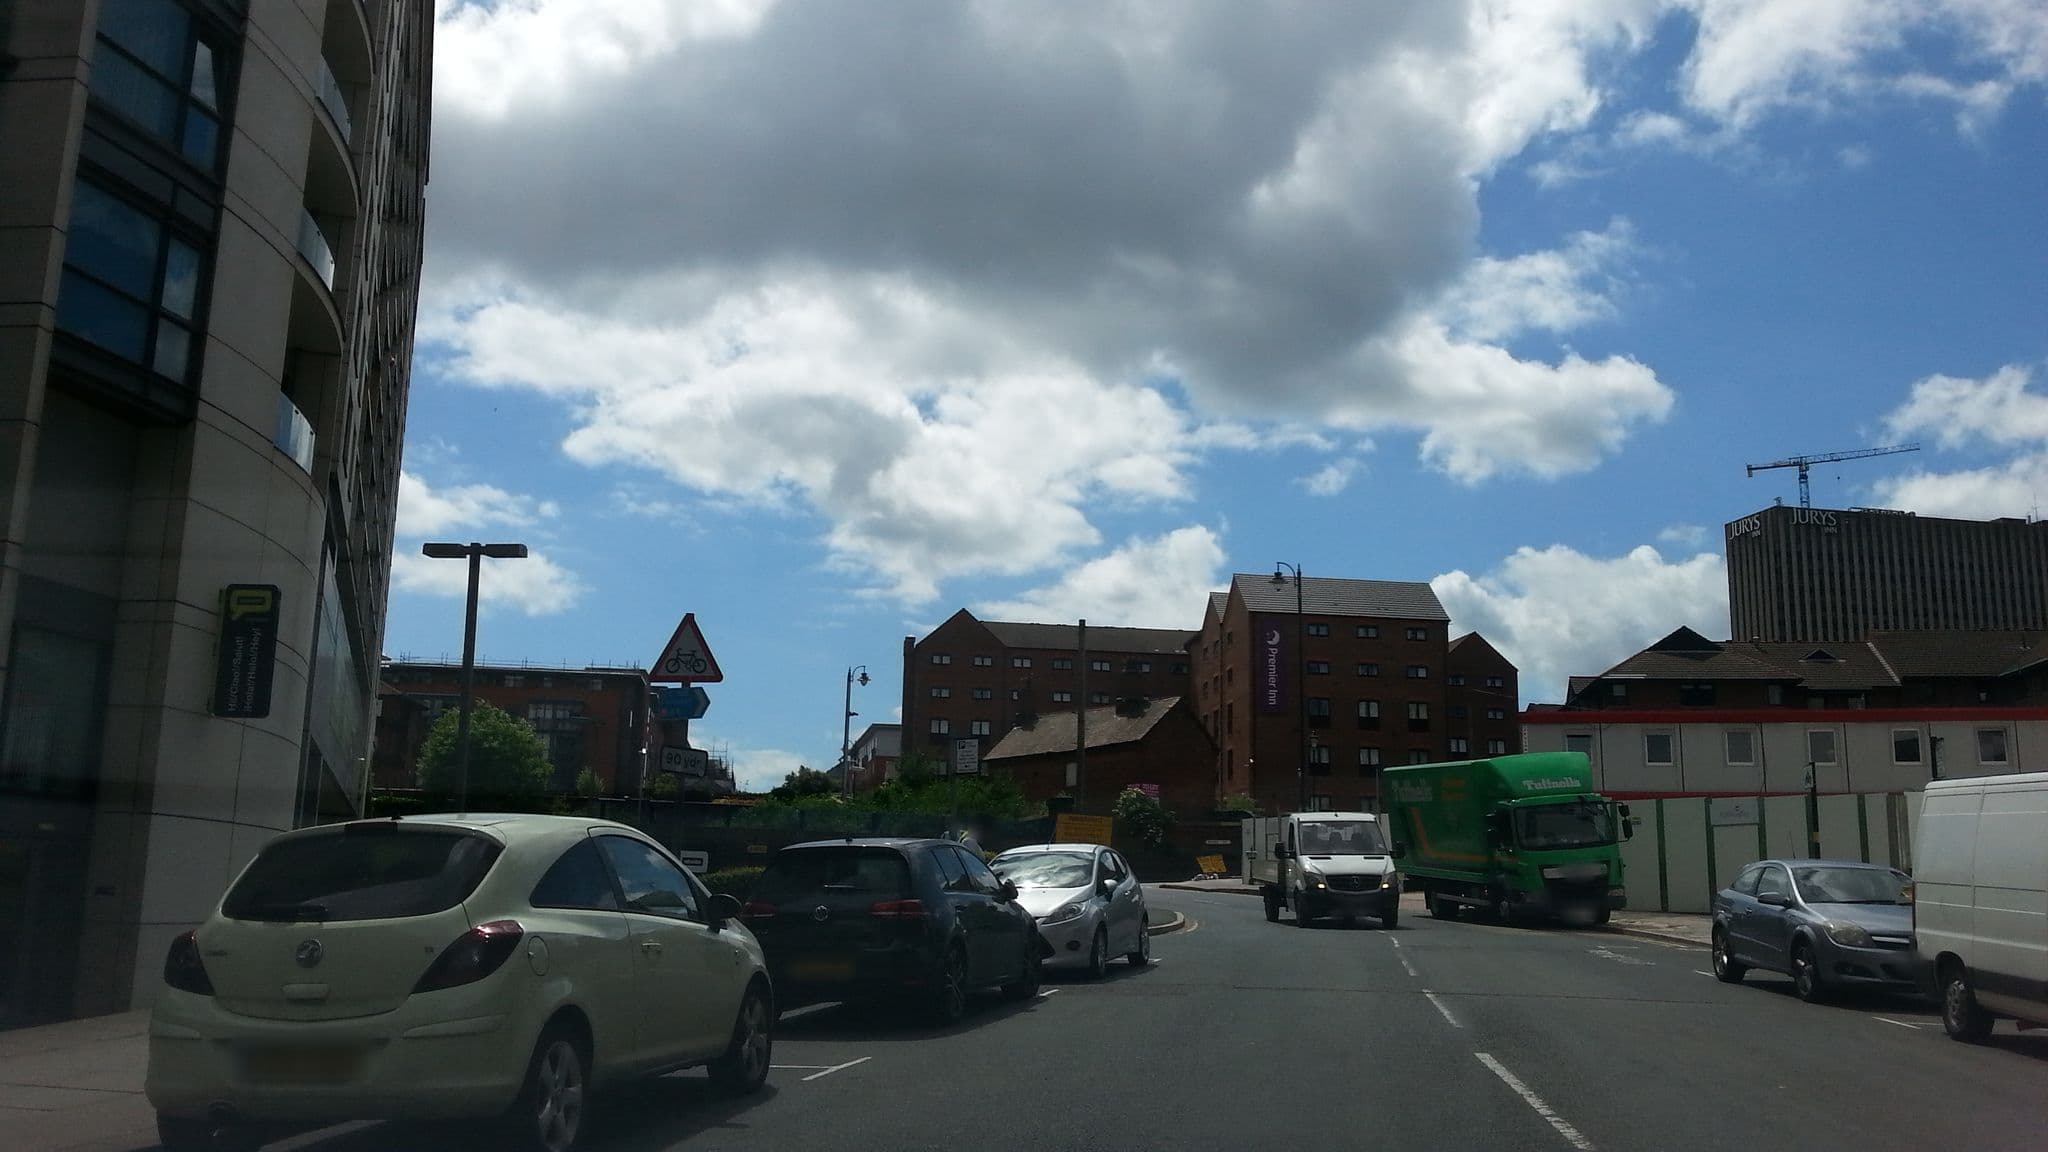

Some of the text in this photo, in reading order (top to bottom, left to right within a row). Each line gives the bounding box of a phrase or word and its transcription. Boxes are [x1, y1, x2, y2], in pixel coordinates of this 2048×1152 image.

[1791, 508, 1837, 526] JURYS
[1729, 514, 1760, 540] JURYS
[1751, 529, 1760, 538] INN
[1824, 526, 1838, 534] INN
[1268, 647, 1279, 705] Premier Inn
[666, 752, 682, 766] 90
